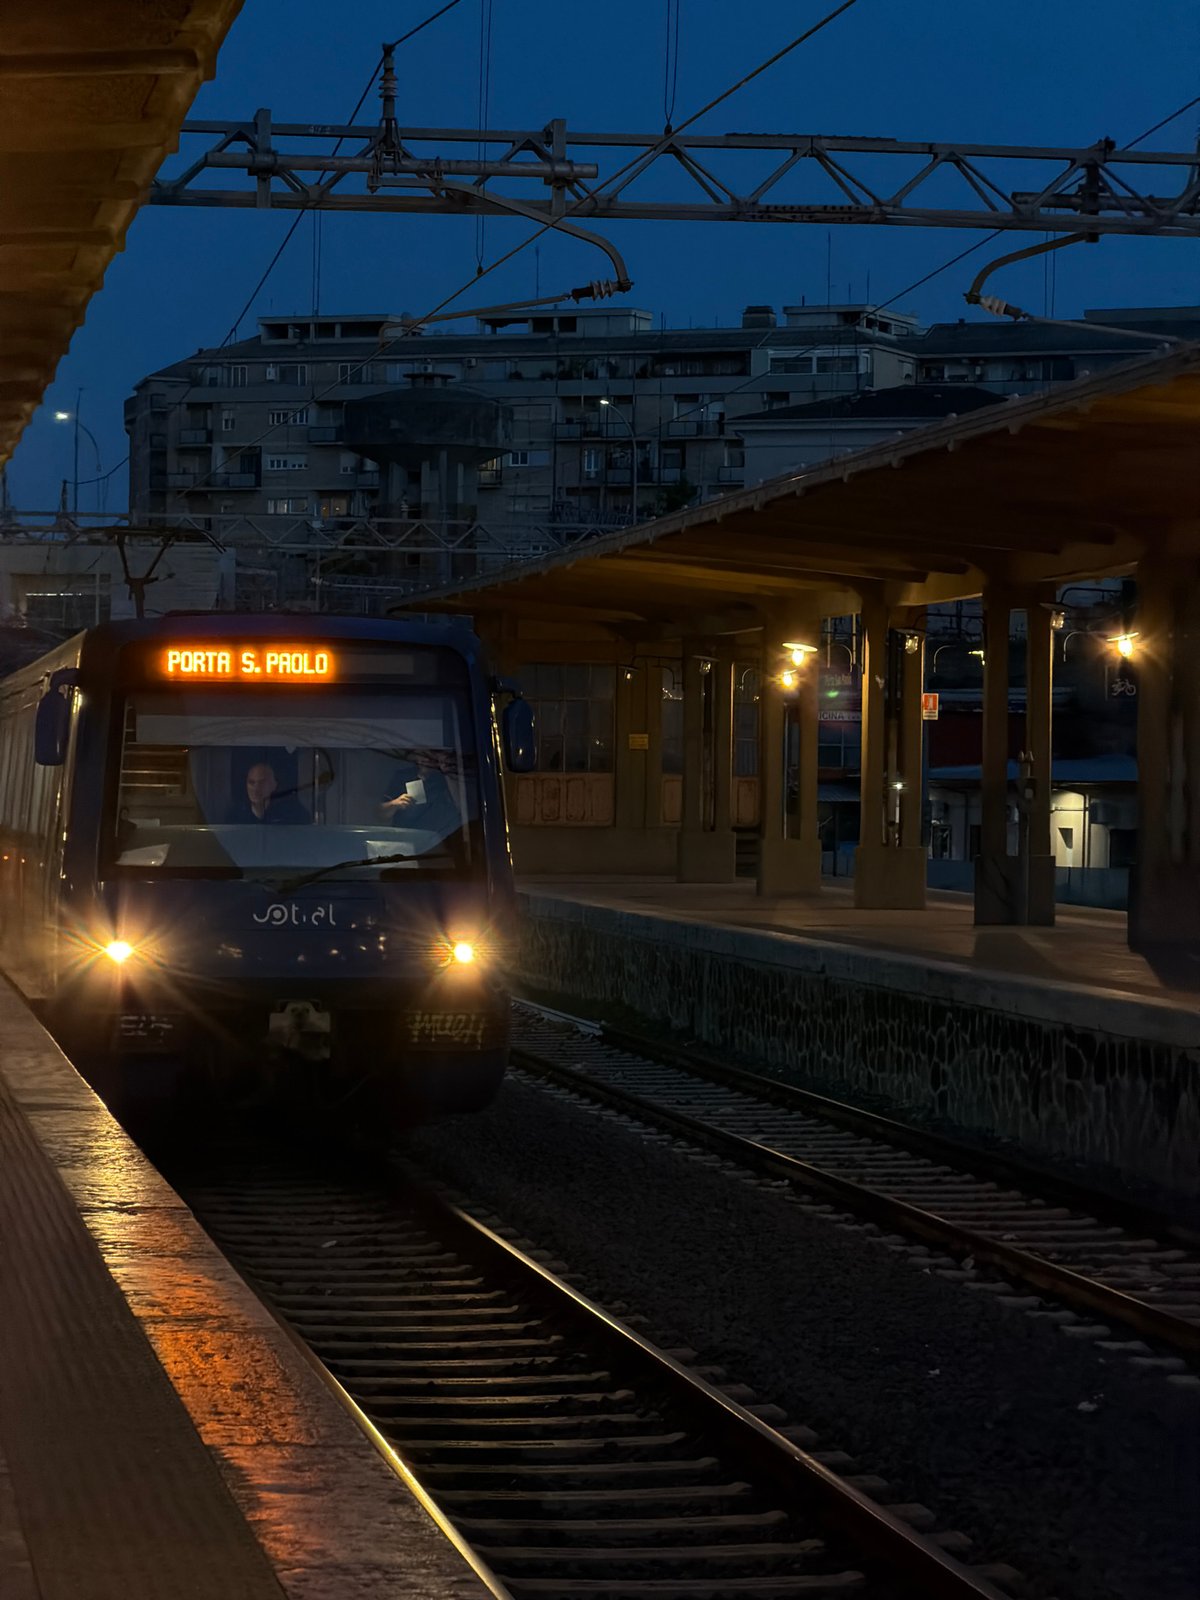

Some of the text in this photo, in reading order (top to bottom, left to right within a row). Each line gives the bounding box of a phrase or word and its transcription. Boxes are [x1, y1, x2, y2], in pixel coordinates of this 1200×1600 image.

[167, 650, 329, 675] PORTA S. PAOLO
[818, 711, 845, 721] ICINA
